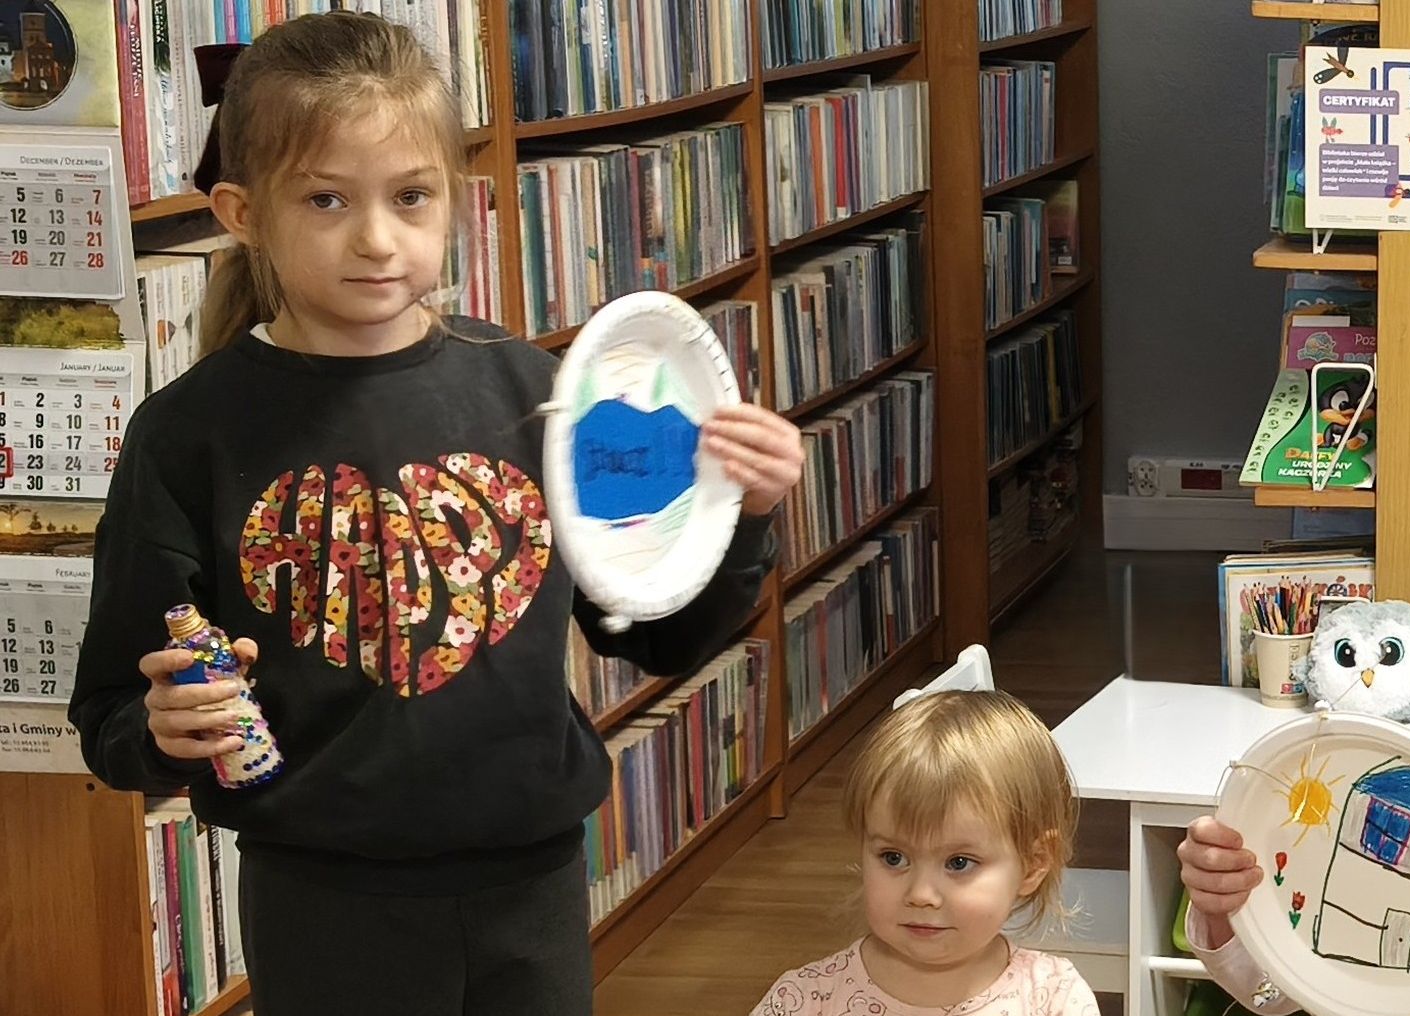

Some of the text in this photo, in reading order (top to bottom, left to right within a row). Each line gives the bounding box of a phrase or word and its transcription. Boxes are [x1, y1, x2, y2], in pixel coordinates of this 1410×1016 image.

[1323, 96, 1396, 107] CERTYFIKAT
[20, 156, 59, 164] DECEMBER
[65, 157, 103, 166] DEZEMBER
[17, 187, 101, 204] 5 6 7
[10, 208, 103, 225] 12 13 14
[11, 229, 103, 246] 19 20 21
[12, 251, 104, 268] 26 27 28
[36, 393, 44, 407] 2
[74, 394, 82, 408] 3
[112, 395, 121, 410] 4
[36, 413, 44, 428] 9
[66, 415, 82, 429] 10
[105, 416, 120, 430] 11
[29, 434, 44, 448] 16
[66, 436, 82, 450] 17
[105, 437, 121, 451] 18
[27, 455, 44, 469] 23
[65, 456, 82, 471] 24
[27, 476, 43, 491] 30
[65, 477, 81, 492] 31
[239, 452, 552, 698] HAPPY
[7, 619, 53, 635] 5 6
[2, 639, 54, 655] 12 13
[3, 659, 56, 675] 19 20
[3, 679, 57, 695] 26 27
[20, 723, 63, 737] Gminy
